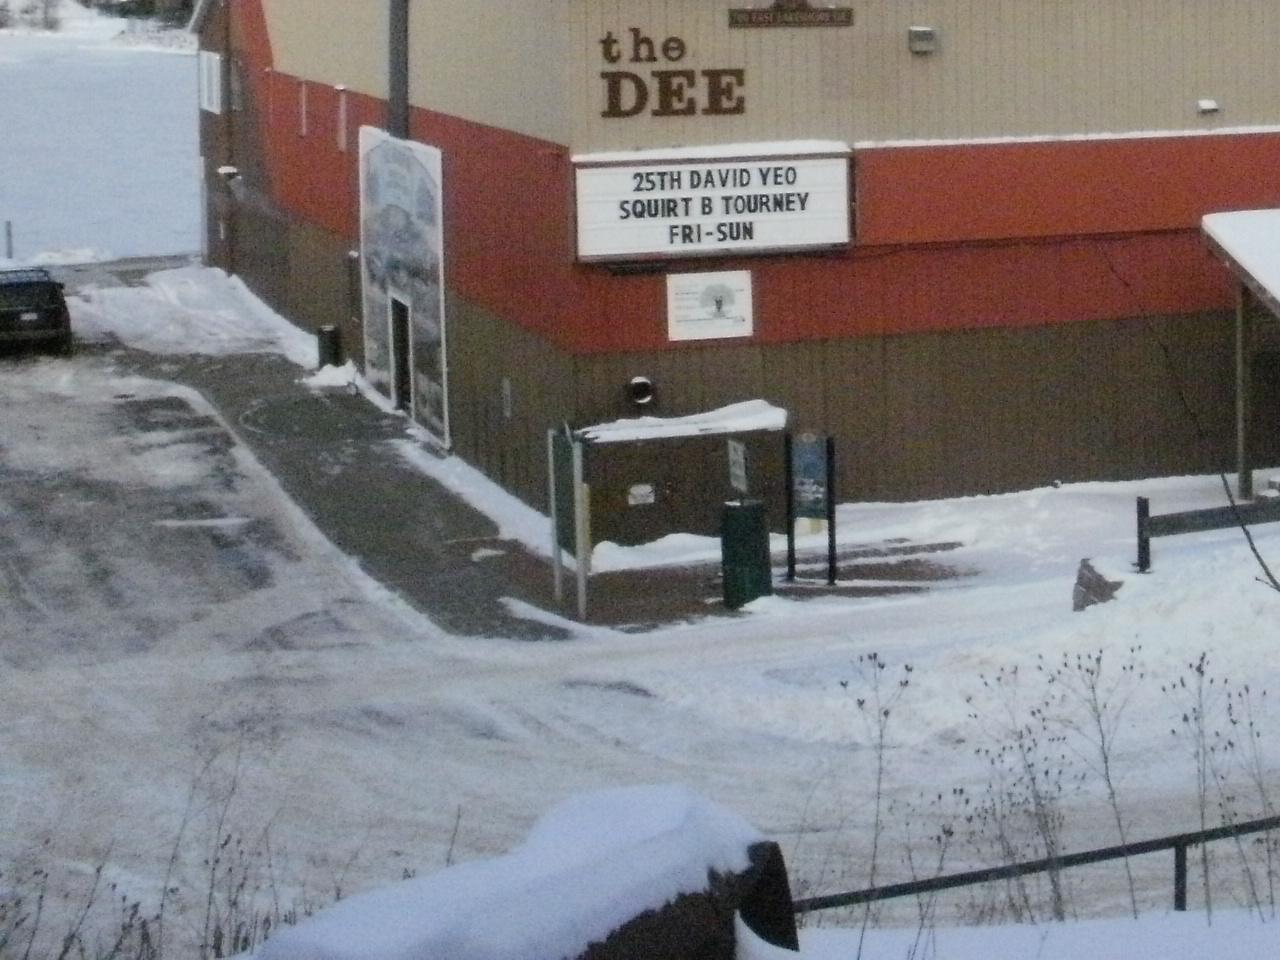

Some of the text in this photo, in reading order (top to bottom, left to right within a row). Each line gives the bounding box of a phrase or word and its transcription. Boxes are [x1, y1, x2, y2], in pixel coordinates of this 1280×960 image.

[600, 27, 686, 63] the
[600, 68, 745, 118] DEE
[633, 166, 797, 192] 25TH DAVID YEO
[619, 192, 809, 220] SQUIRT B TOURNEY
[669, 222, 754, 244] FRI-SUN
